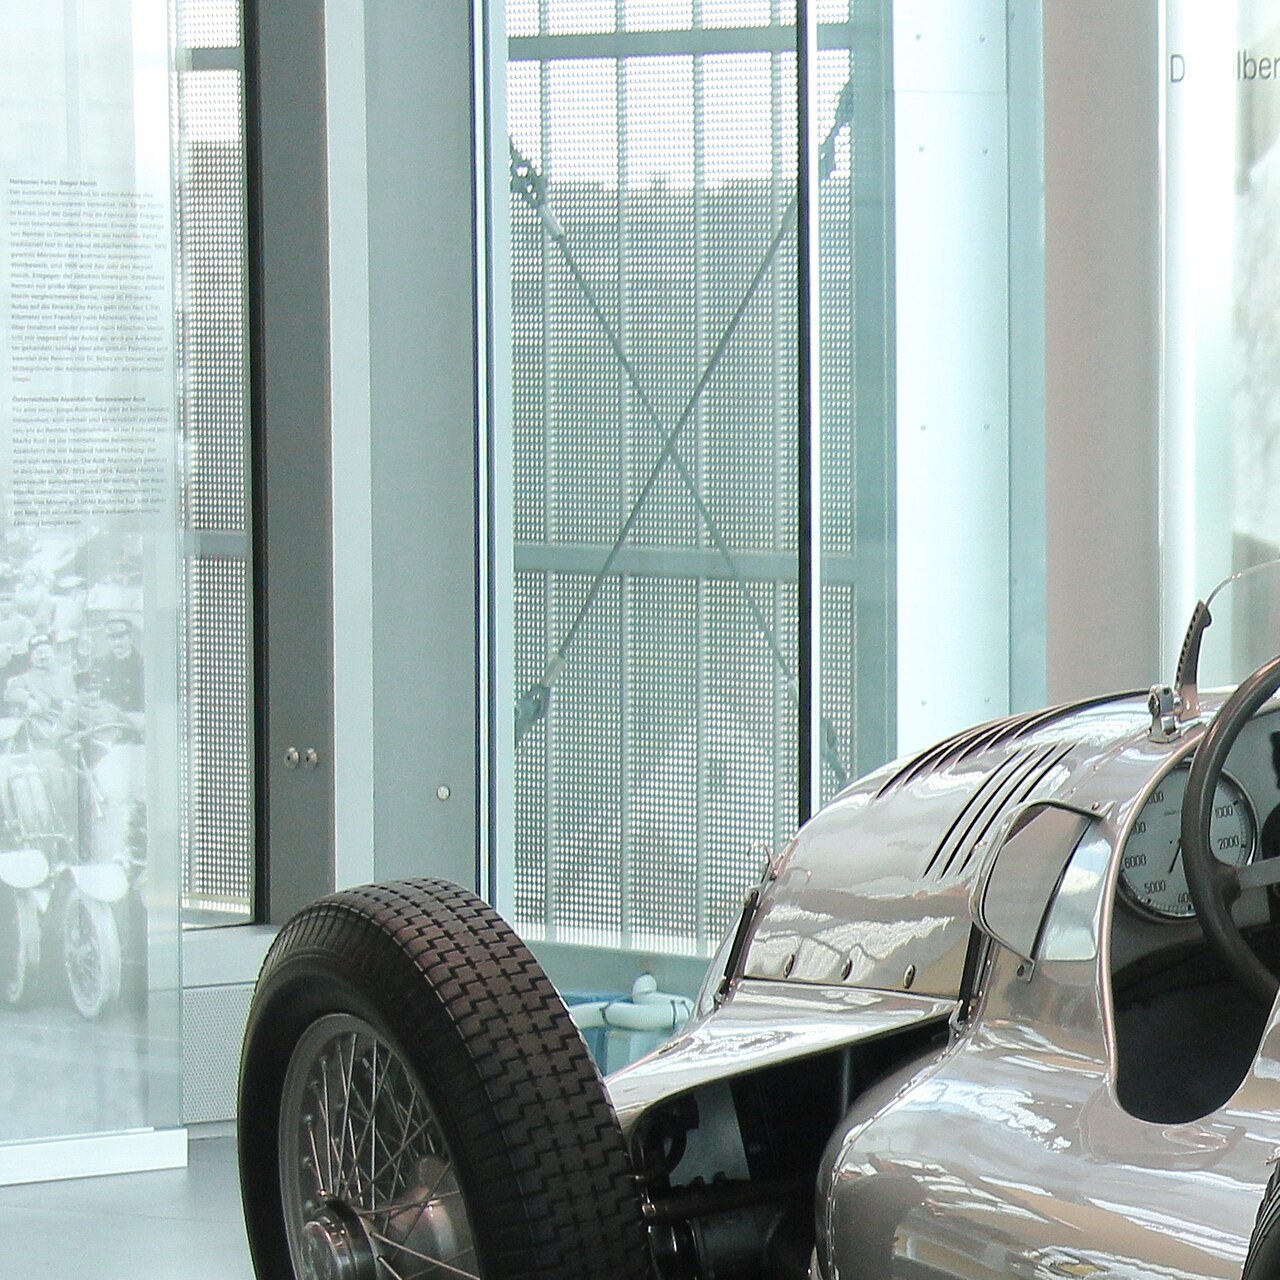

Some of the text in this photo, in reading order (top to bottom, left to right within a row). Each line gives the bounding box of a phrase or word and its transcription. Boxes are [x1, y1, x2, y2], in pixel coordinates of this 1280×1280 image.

[1218, 836, 1239, 850] 2000
[1124, 854, 1147, 869] 6000
[1144, 880, 1166, 895] 5000
